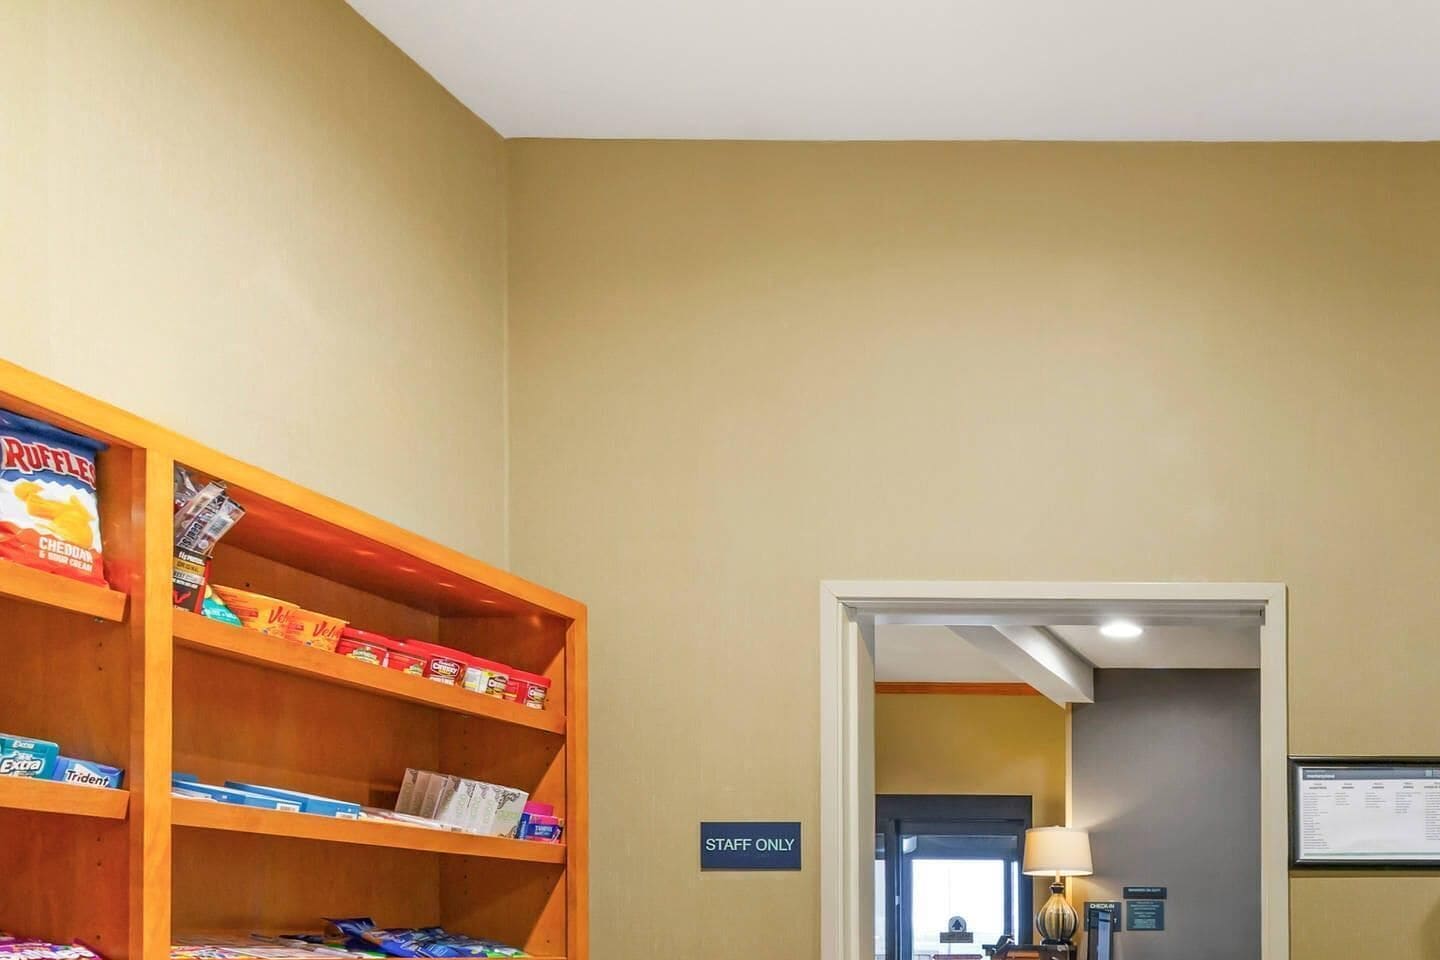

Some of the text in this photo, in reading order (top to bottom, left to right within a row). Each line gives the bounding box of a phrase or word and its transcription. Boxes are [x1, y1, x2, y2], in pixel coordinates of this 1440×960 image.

[2, 438, 96, 490] RUFFLES
[39, 537, 93, 562] CHEDDAR
[1, 758, 41, 775] Extra
[67, 770, 110, 787] Trident
[706, 838, 794, 851] STAFF ONLY
